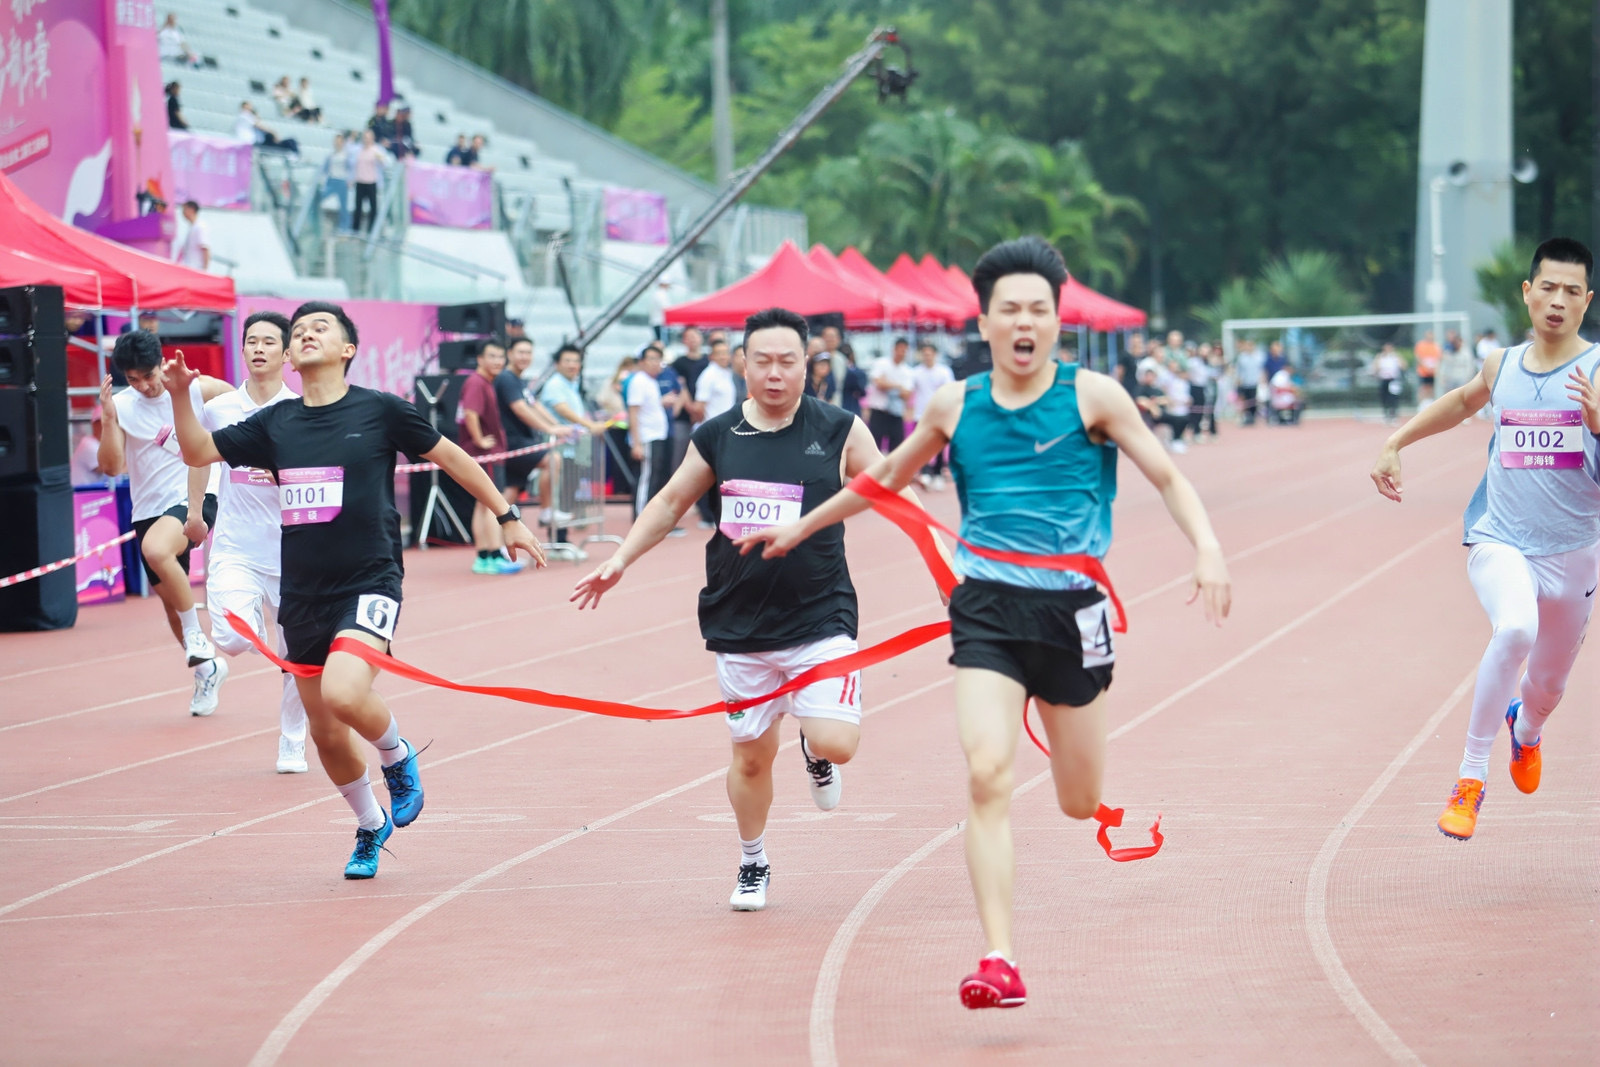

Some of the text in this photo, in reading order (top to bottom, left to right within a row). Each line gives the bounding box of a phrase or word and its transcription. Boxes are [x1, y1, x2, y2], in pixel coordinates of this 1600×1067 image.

[1515, 430, 1564, 448] 0102
[285, 486, 325, 506] 0101
[734, 501, 781, 521] 0901
[366, 598, 389, 630] 6
[1094, 608, 1113, 657] 4
